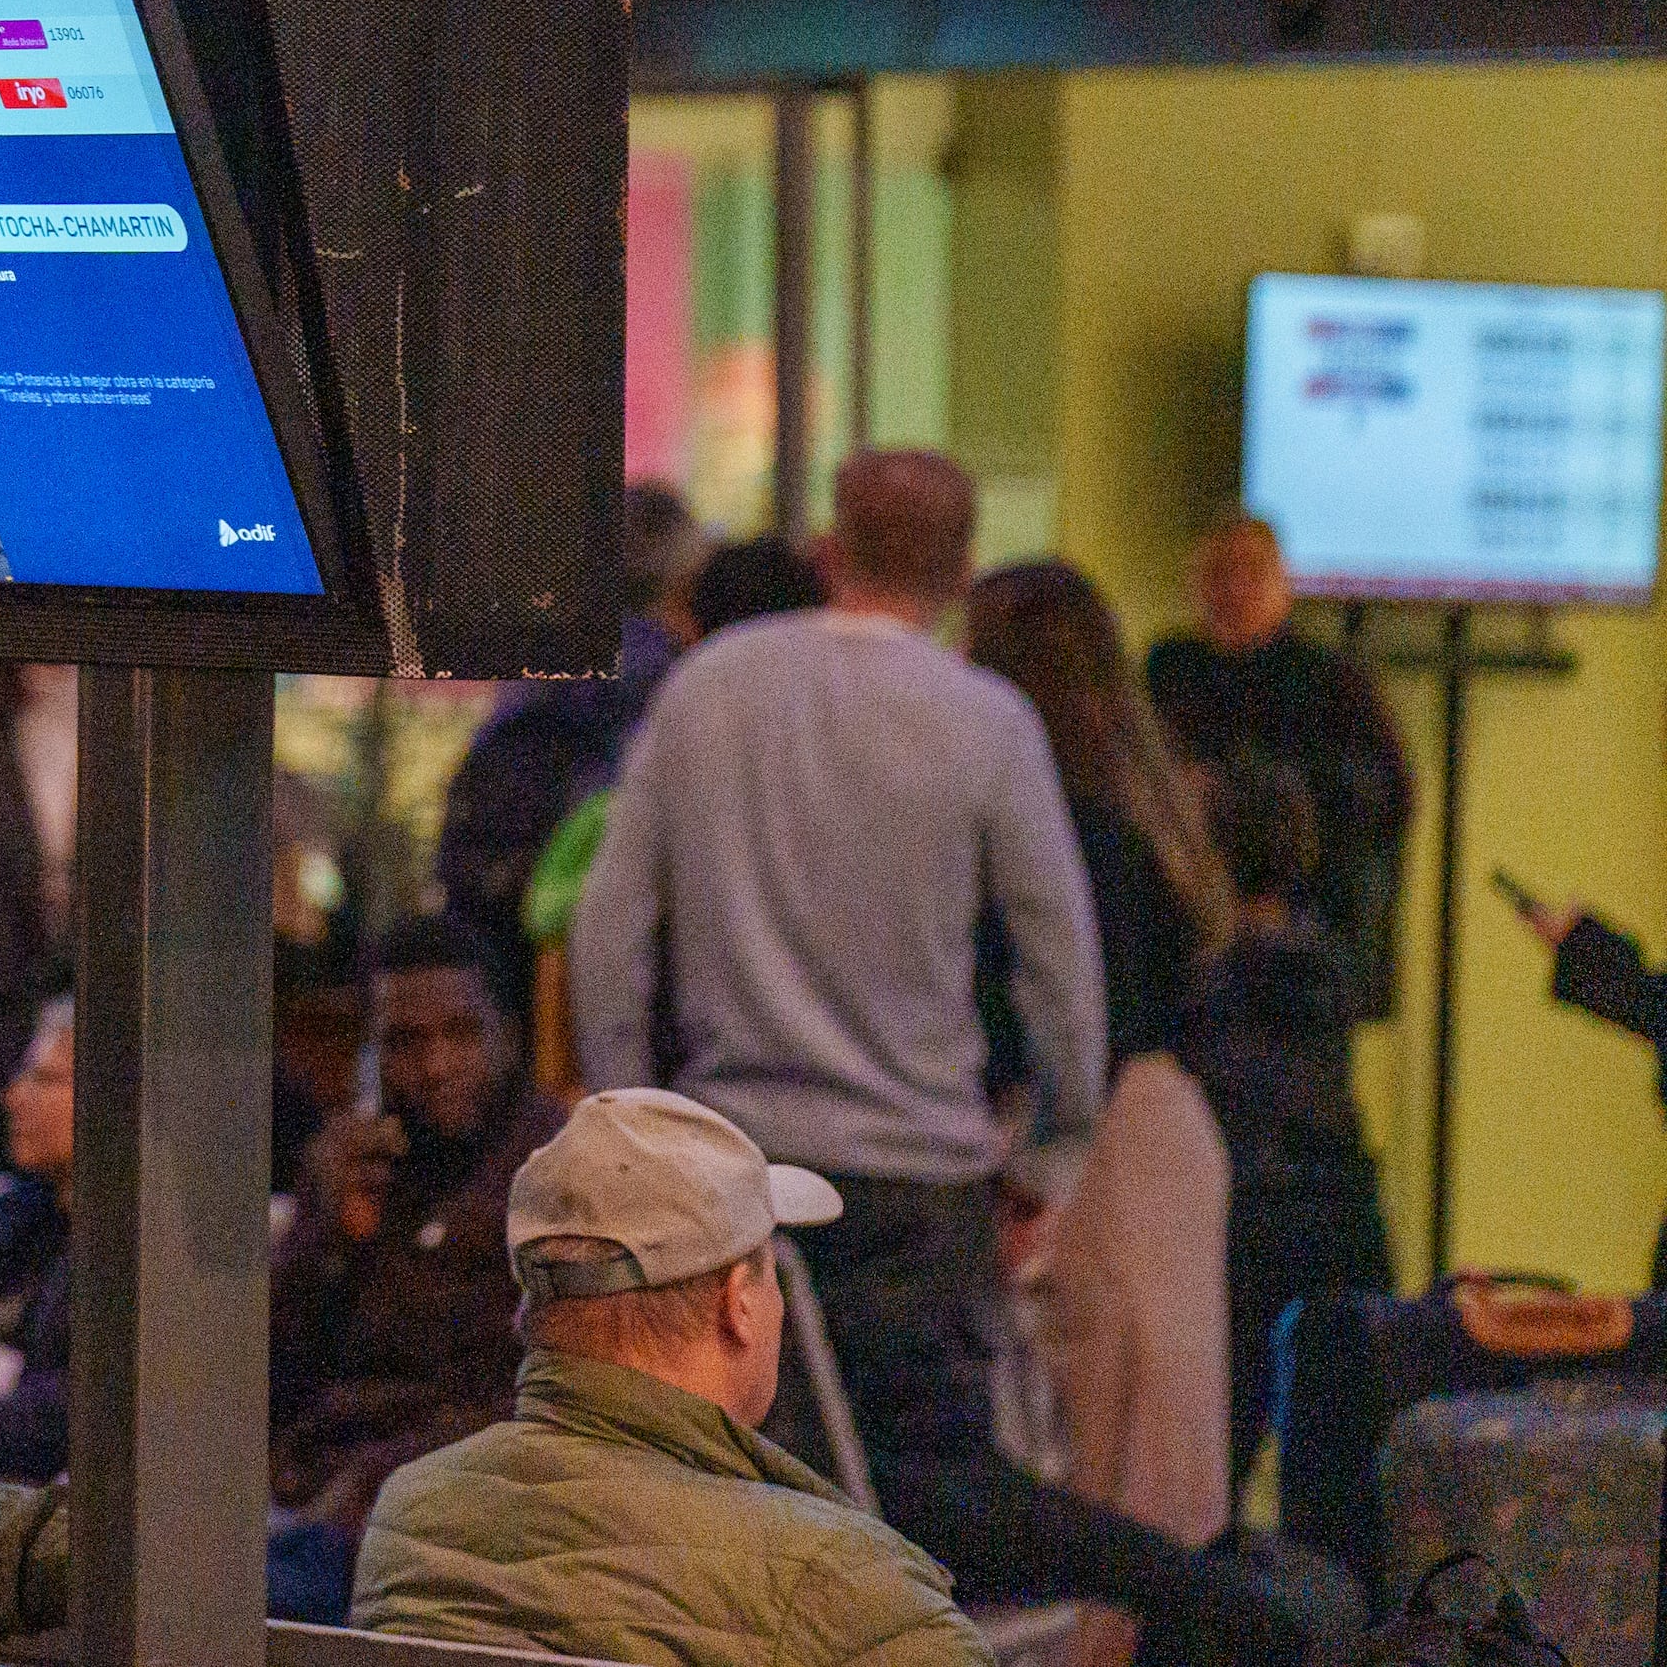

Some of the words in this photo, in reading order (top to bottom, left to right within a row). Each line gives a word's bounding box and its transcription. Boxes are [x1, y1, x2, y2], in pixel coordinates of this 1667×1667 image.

[48, 27, 85, 41] 13901
[15, 82, 45, 104] iryo
[67, 86, 104, 99] 06076
[238, 524, 276, 541] adif
